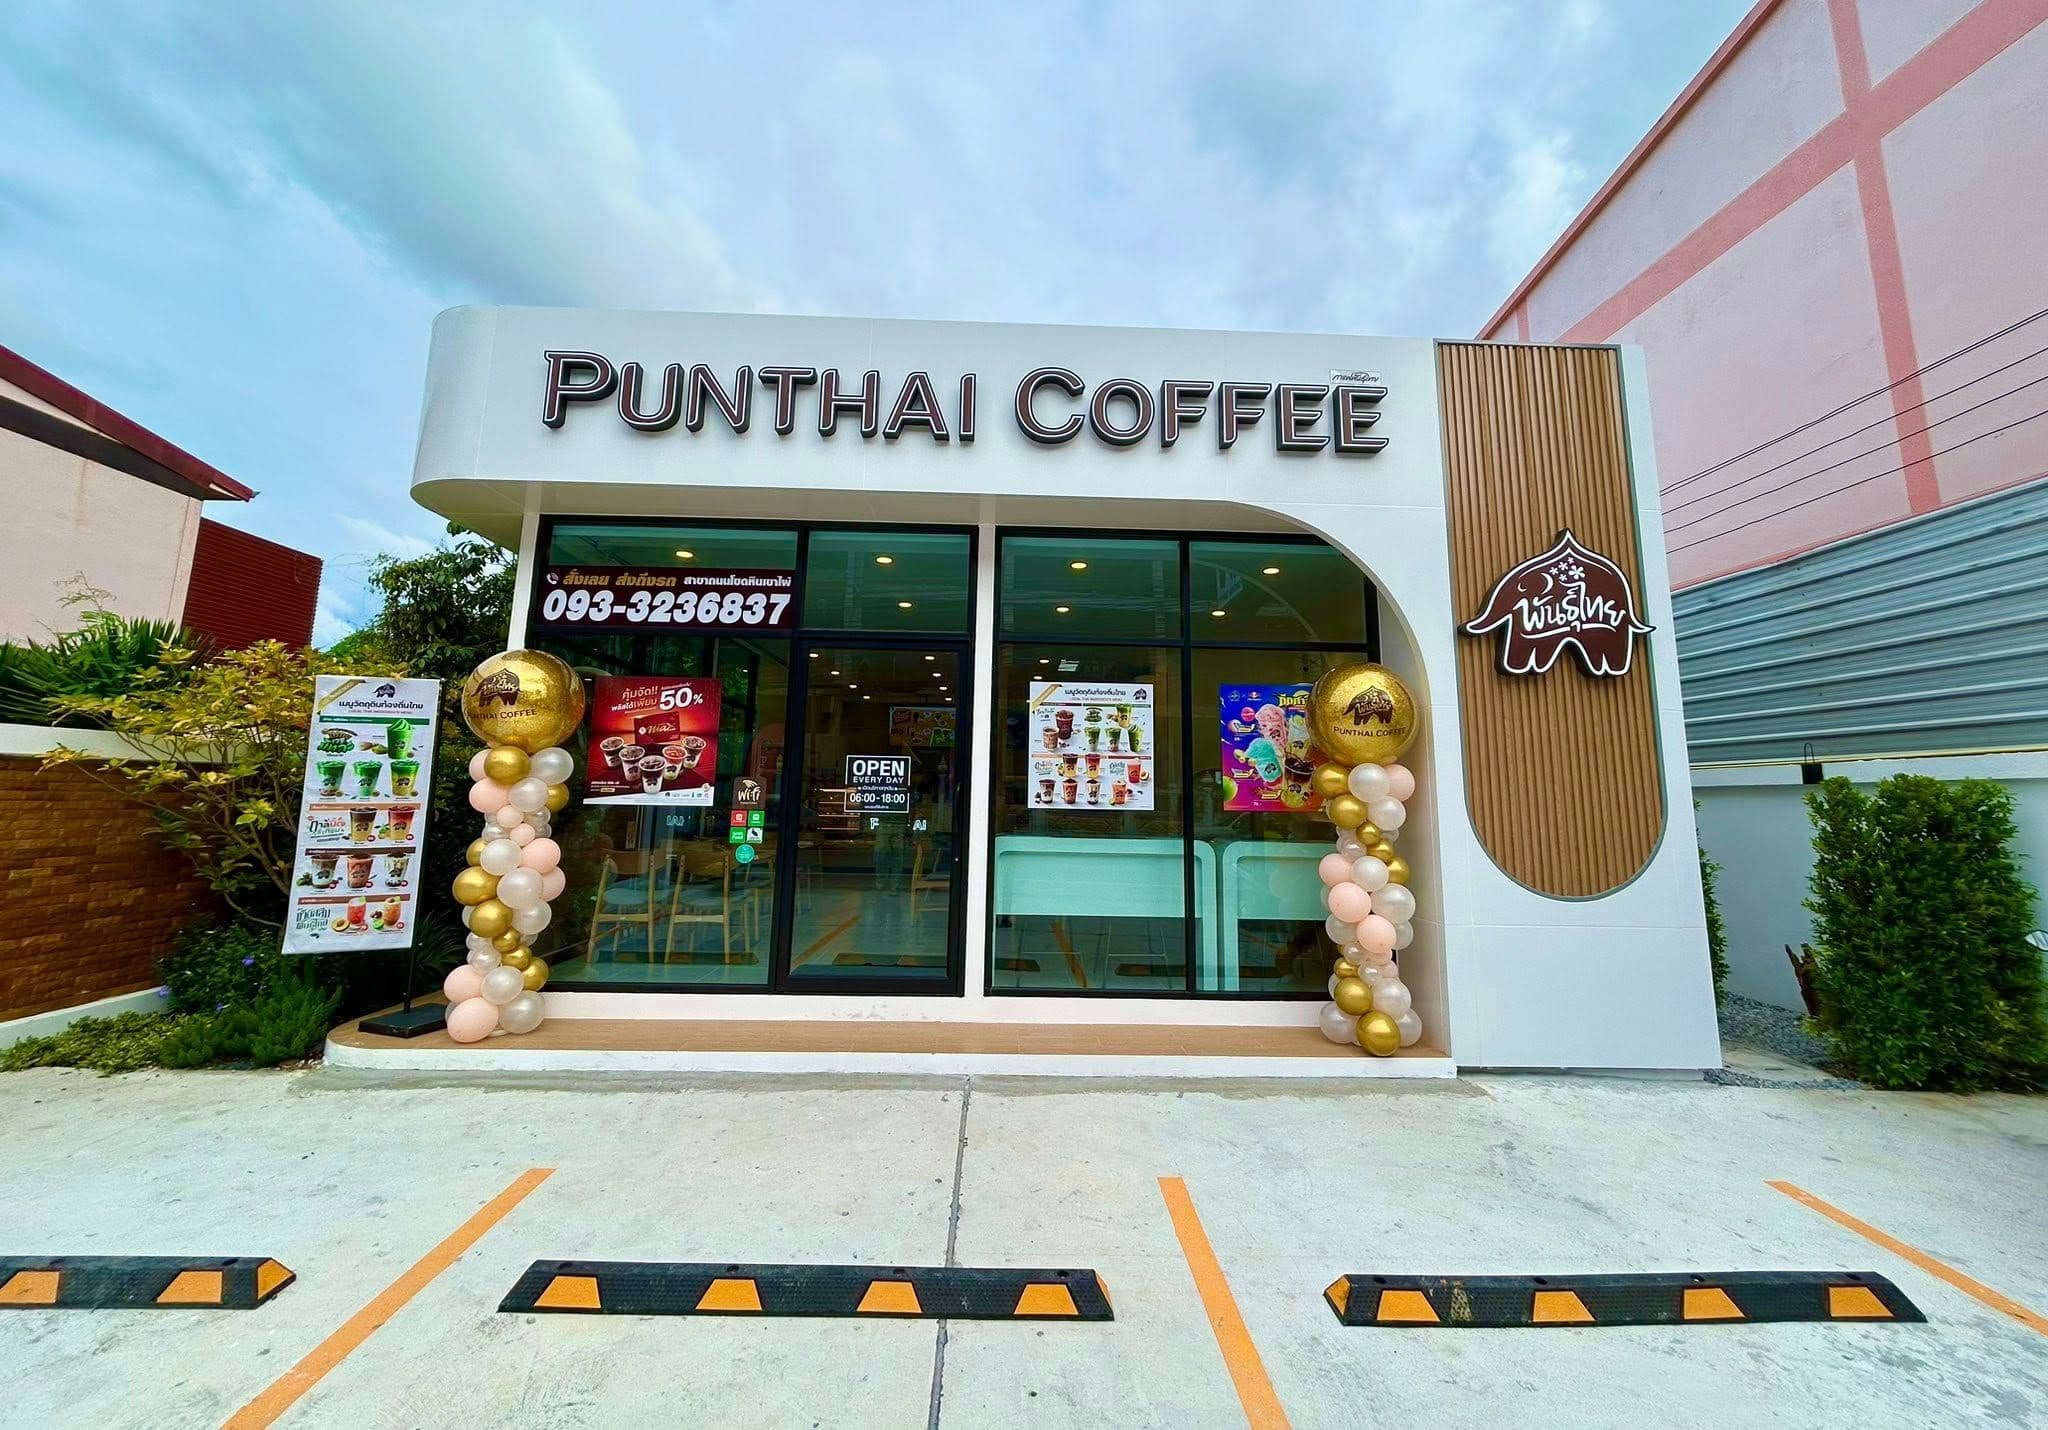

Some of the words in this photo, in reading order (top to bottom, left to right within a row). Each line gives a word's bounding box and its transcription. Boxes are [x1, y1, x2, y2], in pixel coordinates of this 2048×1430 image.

[543, 350, 976, 442] PUNTHAI
[1015, 366, 1390, 453] COFFEE
[562, 568, 609, 585] สั่งเลย
[615, 572, 677, 587] ส่งถึงรถ
[543, 589, 792, 625] 093-3236837
[1513, 580, 1626, 632] พันธุ์ไทย
[659, 687, 704, 711] 50%
[500, 708, 538, 720] COFFEE
[1333, 726, 1373, 737] PUNTHAI
[853, 760, 905, 776] OPEN
[853, 776, 883, 784] EVERY
[886, 776, 904, 784] DAY
